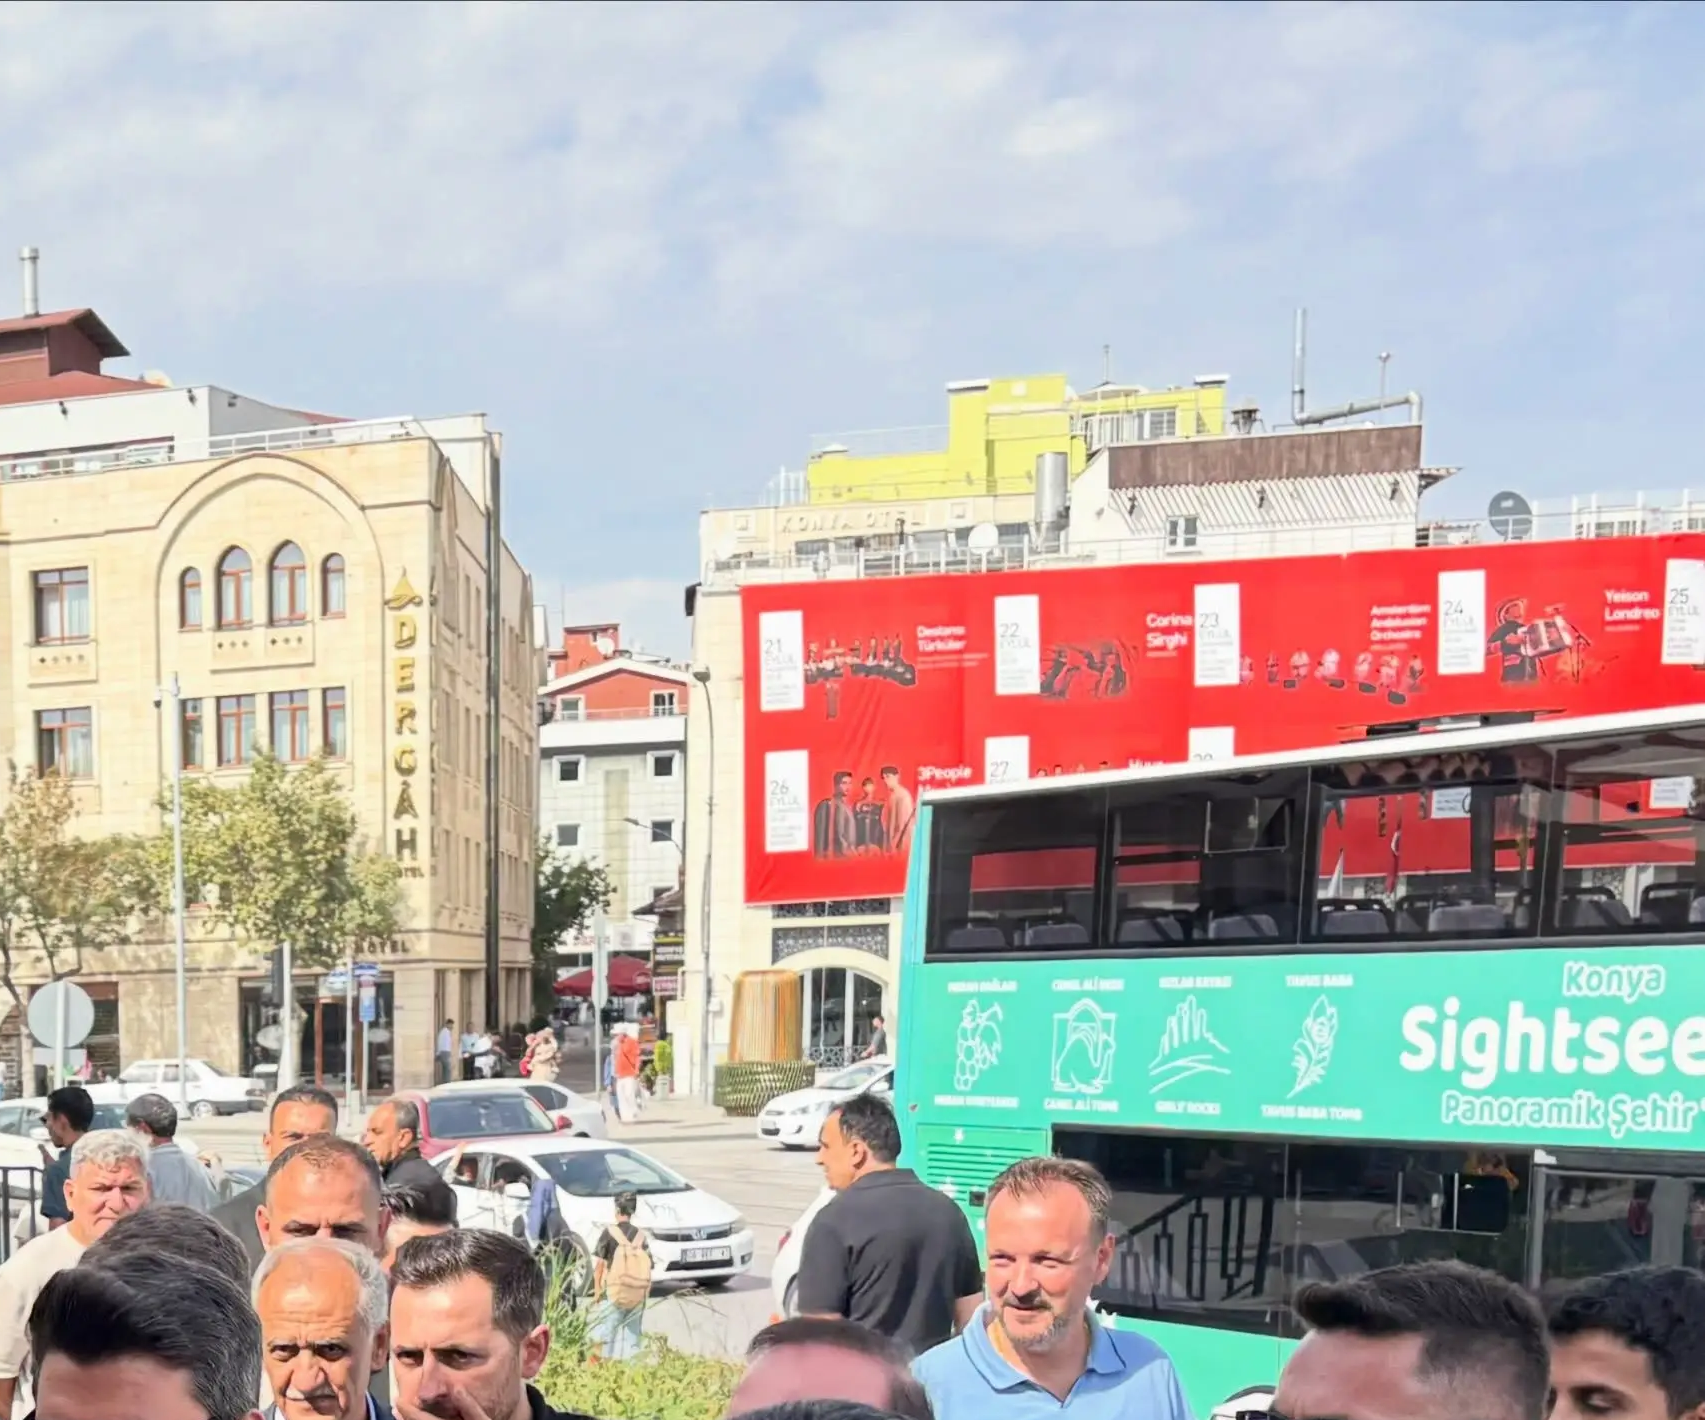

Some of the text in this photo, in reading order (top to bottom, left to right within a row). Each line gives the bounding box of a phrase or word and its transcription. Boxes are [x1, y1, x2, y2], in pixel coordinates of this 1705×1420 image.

[1669, 588, 1689, 604] 25
[1444, 600, 1463, 615] 24
[1146, 612, 1193, 628] Corina
[1200, 612, 1219, 628] 23
[1000, 623, 1019, 637] 22
[765, 638, 782, 654] 21
[990, 761, 1009, 777] 27
[770, 780, 789, 796] 26
[1562, 961, 1666, 1004] Konya
[1441, 1089, 1698, 1139] Panoramik Şehir
